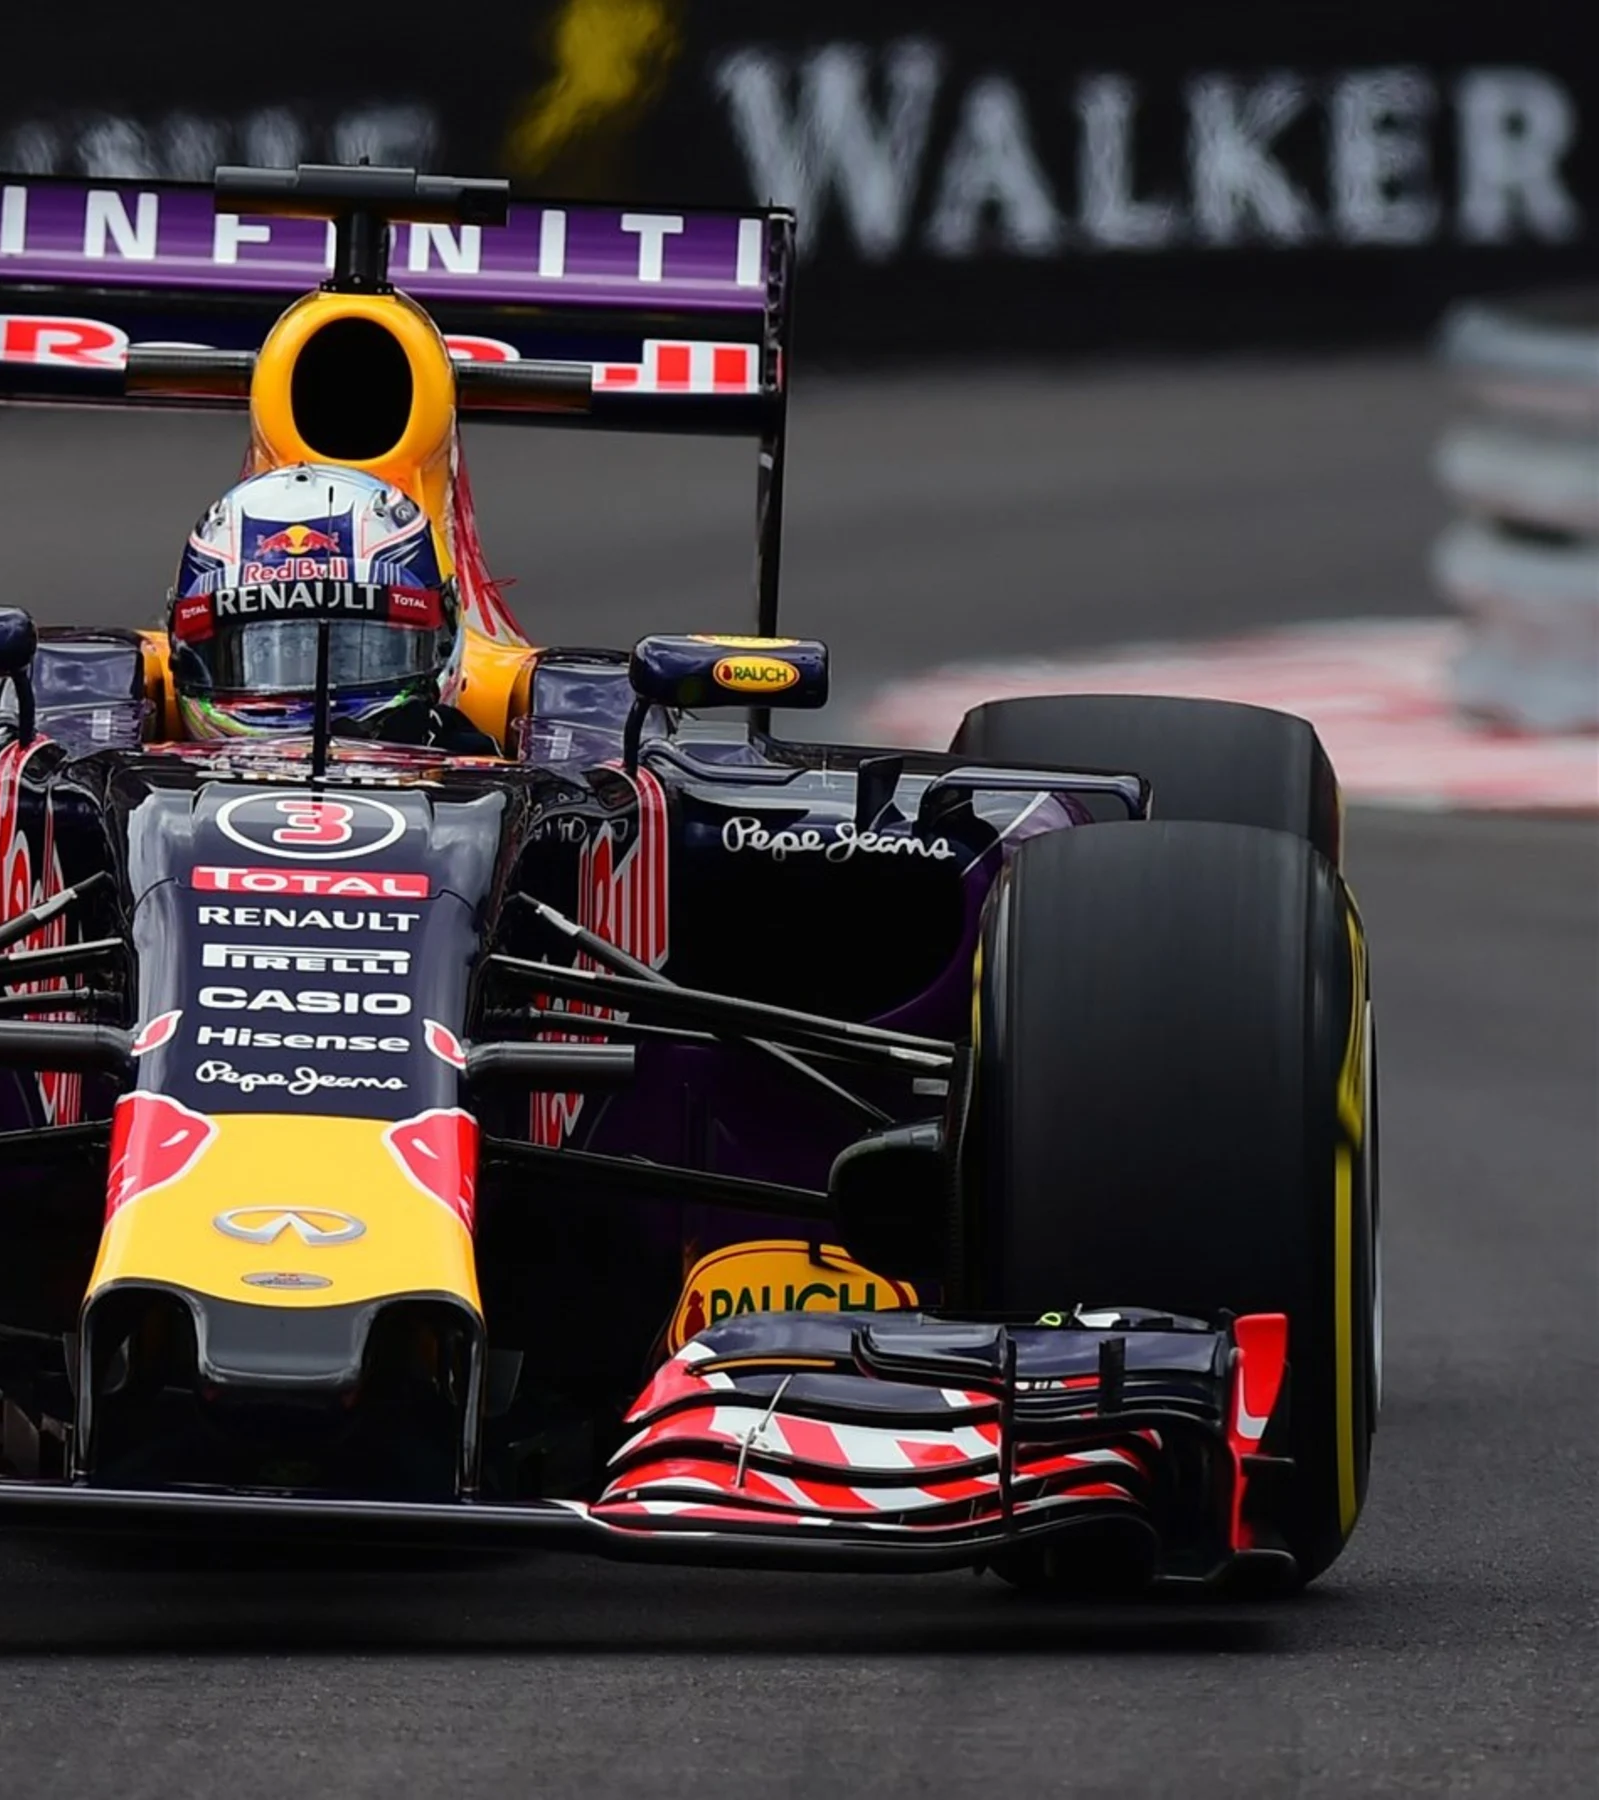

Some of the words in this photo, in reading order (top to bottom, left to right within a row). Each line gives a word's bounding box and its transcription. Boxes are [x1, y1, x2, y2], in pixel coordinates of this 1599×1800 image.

[712, 35, 1578, 258] WALKER
[245, 559, 293, 583] Red
[296, 557, 348, 581] Bull
[215, 582, 382, 616] RENAULT
[392, 593, 428, 609] TOTAL
[734, 665, 788, 683] RAUCH
[272, 800, 354, 846] 3
[722, 816, 826, 861] Pepe
[825, 822, 956, 862] Jeans
[197, 867, 422, 897] TOTAL
[198, 906, 420, 932] RENAULT
[202, 943, 411, 975] PIRELLI
[198, 986, 412, 1015] CASIO
[197, 1026, 411, 1052] Hisense
[195, 1060, 288, 1094] Pepe
[287, 1066, 408, 1096] Jeans
